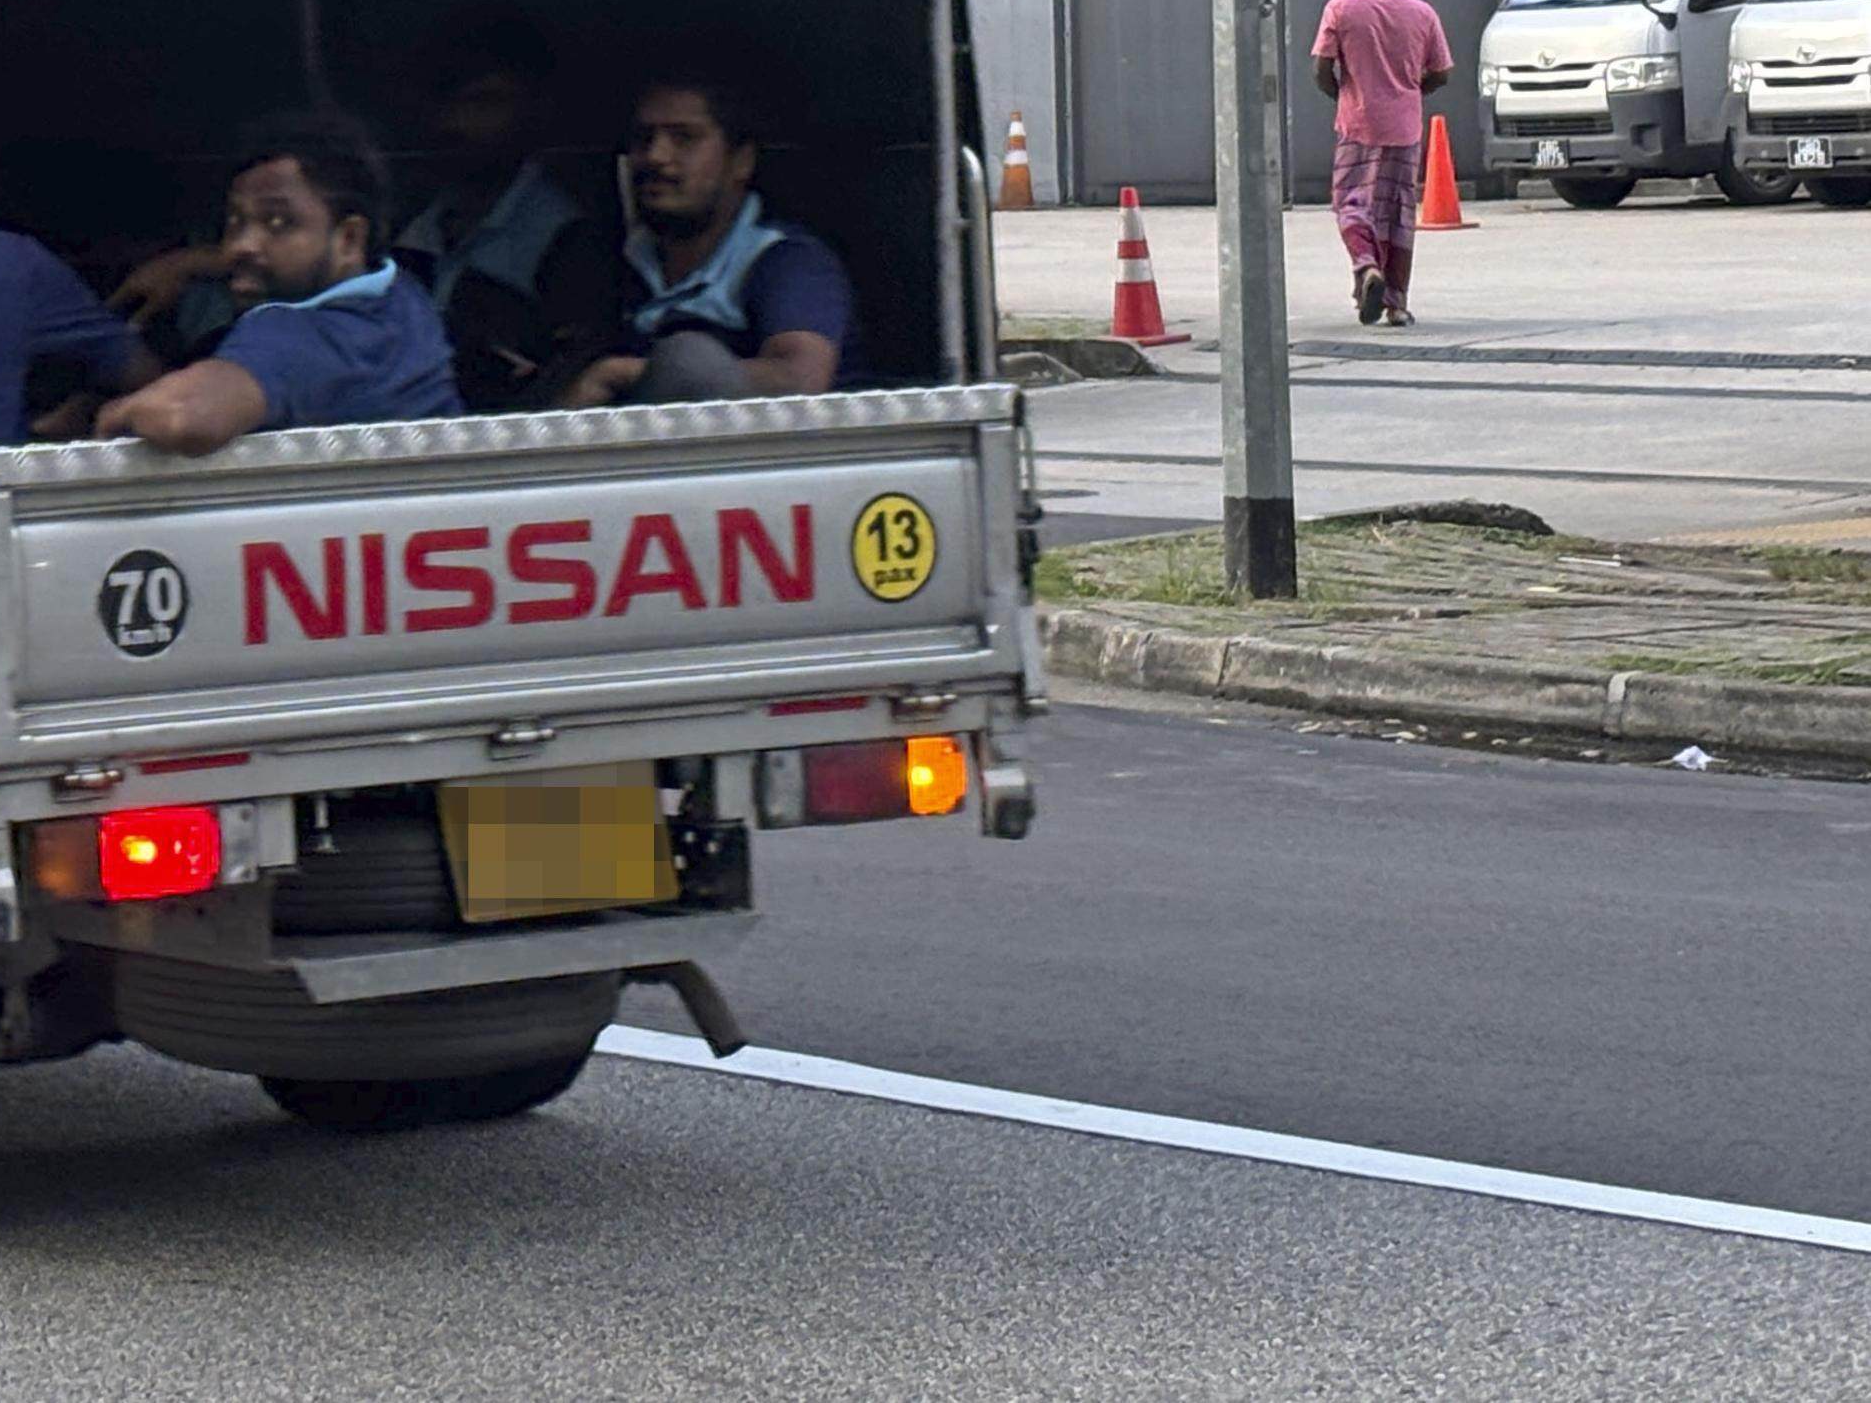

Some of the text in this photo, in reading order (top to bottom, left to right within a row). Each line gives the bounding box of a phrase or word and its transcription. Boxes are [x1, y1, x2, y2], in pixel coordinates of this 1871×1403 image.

[868, 509, 920, 562] 13
[109, 566, 182, 625] 70
[242, 504, 814, 646] NISSAN
[873, 566, 916, 589] pax
